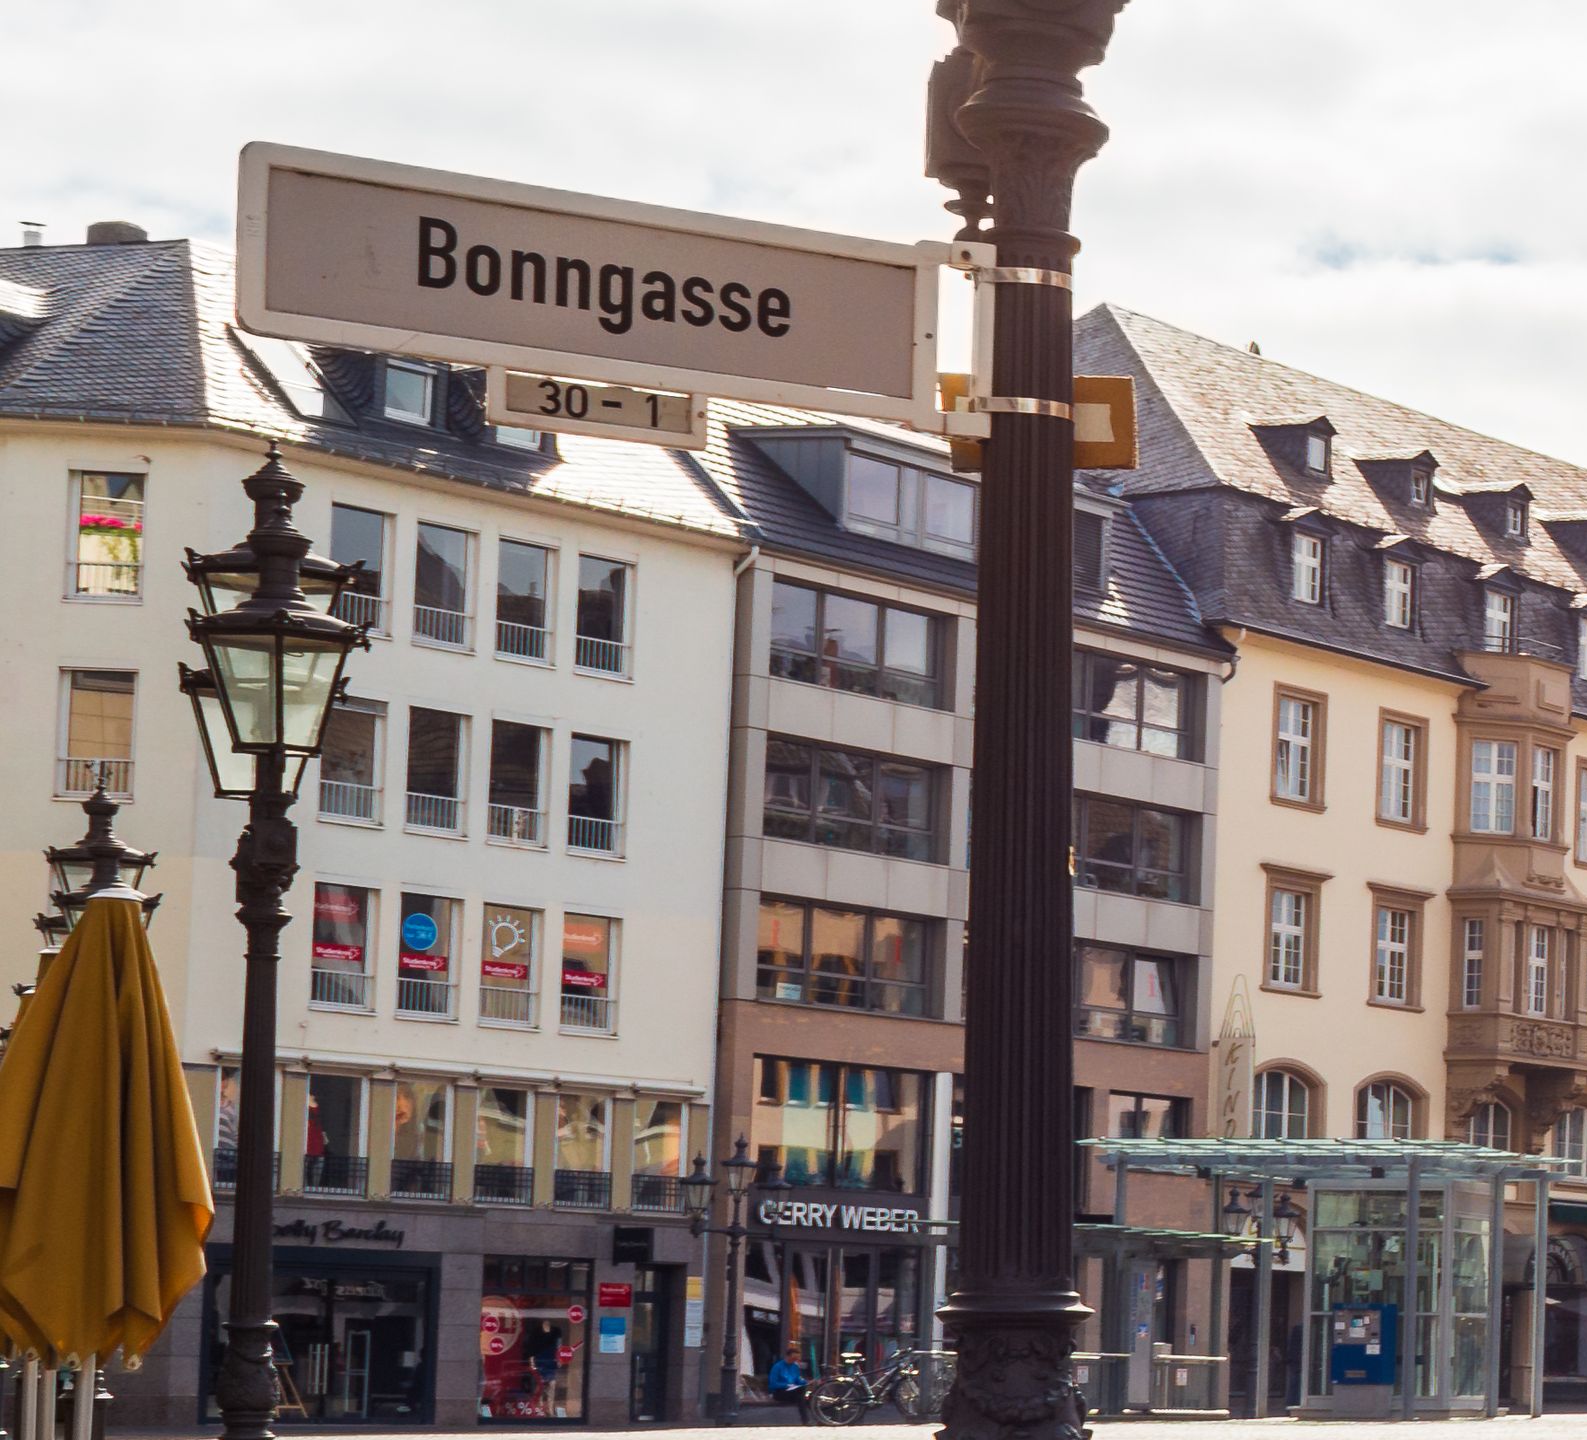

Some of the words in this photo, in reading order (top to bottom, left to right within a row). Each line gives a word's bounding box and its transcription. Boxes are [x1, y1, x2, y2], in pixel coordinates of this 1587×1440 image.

[416, 215, 792, 338] Bonngasse
[537, 380, 589, 418] 30
[644, 393, 660, 428] 1
[759, 1199, 839, 1228] GERRY
[839, 1204, 920, 1234] WEBER
